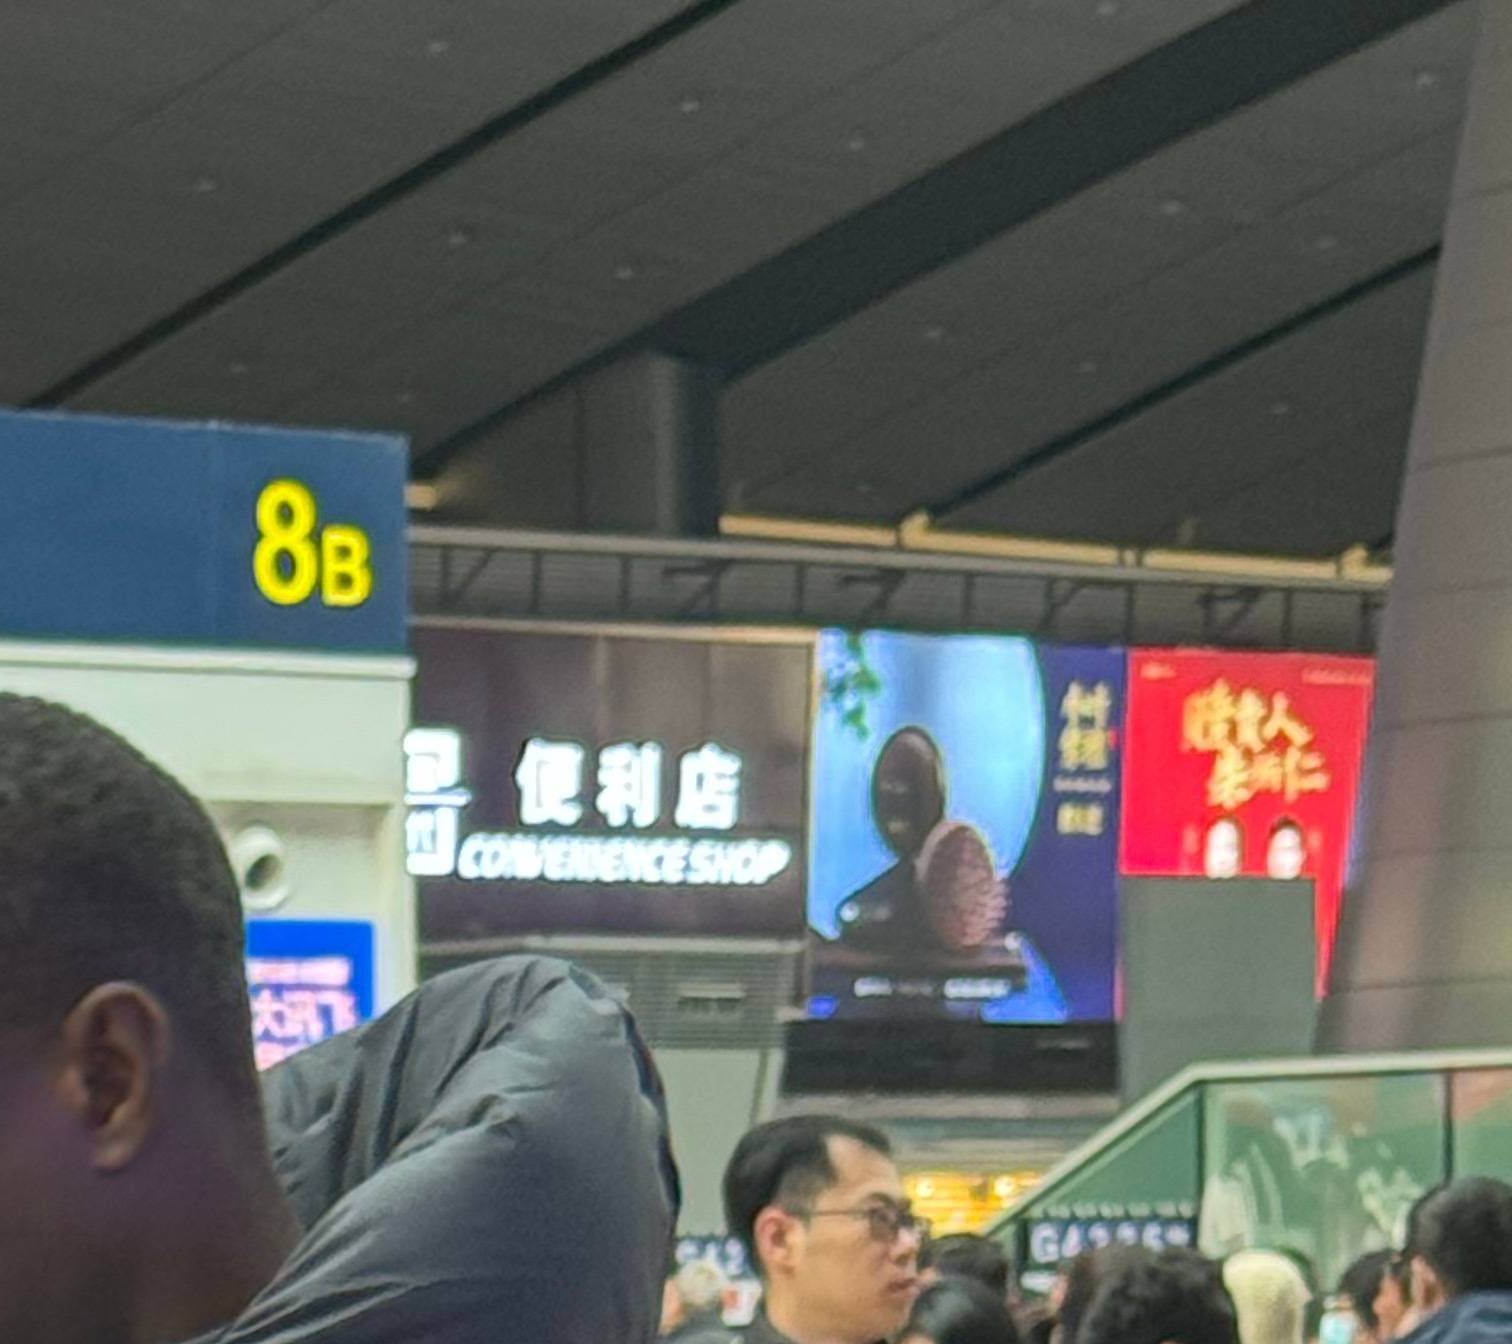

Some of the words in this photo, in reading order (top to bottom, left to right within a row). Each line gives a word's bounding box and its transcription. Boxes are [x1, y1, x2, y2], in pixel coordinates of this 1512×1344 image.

[253, 480, 372, 606] 8B
[515, 738, 742, 829] 便利店
[687, 839, 791, 885] SHOP
